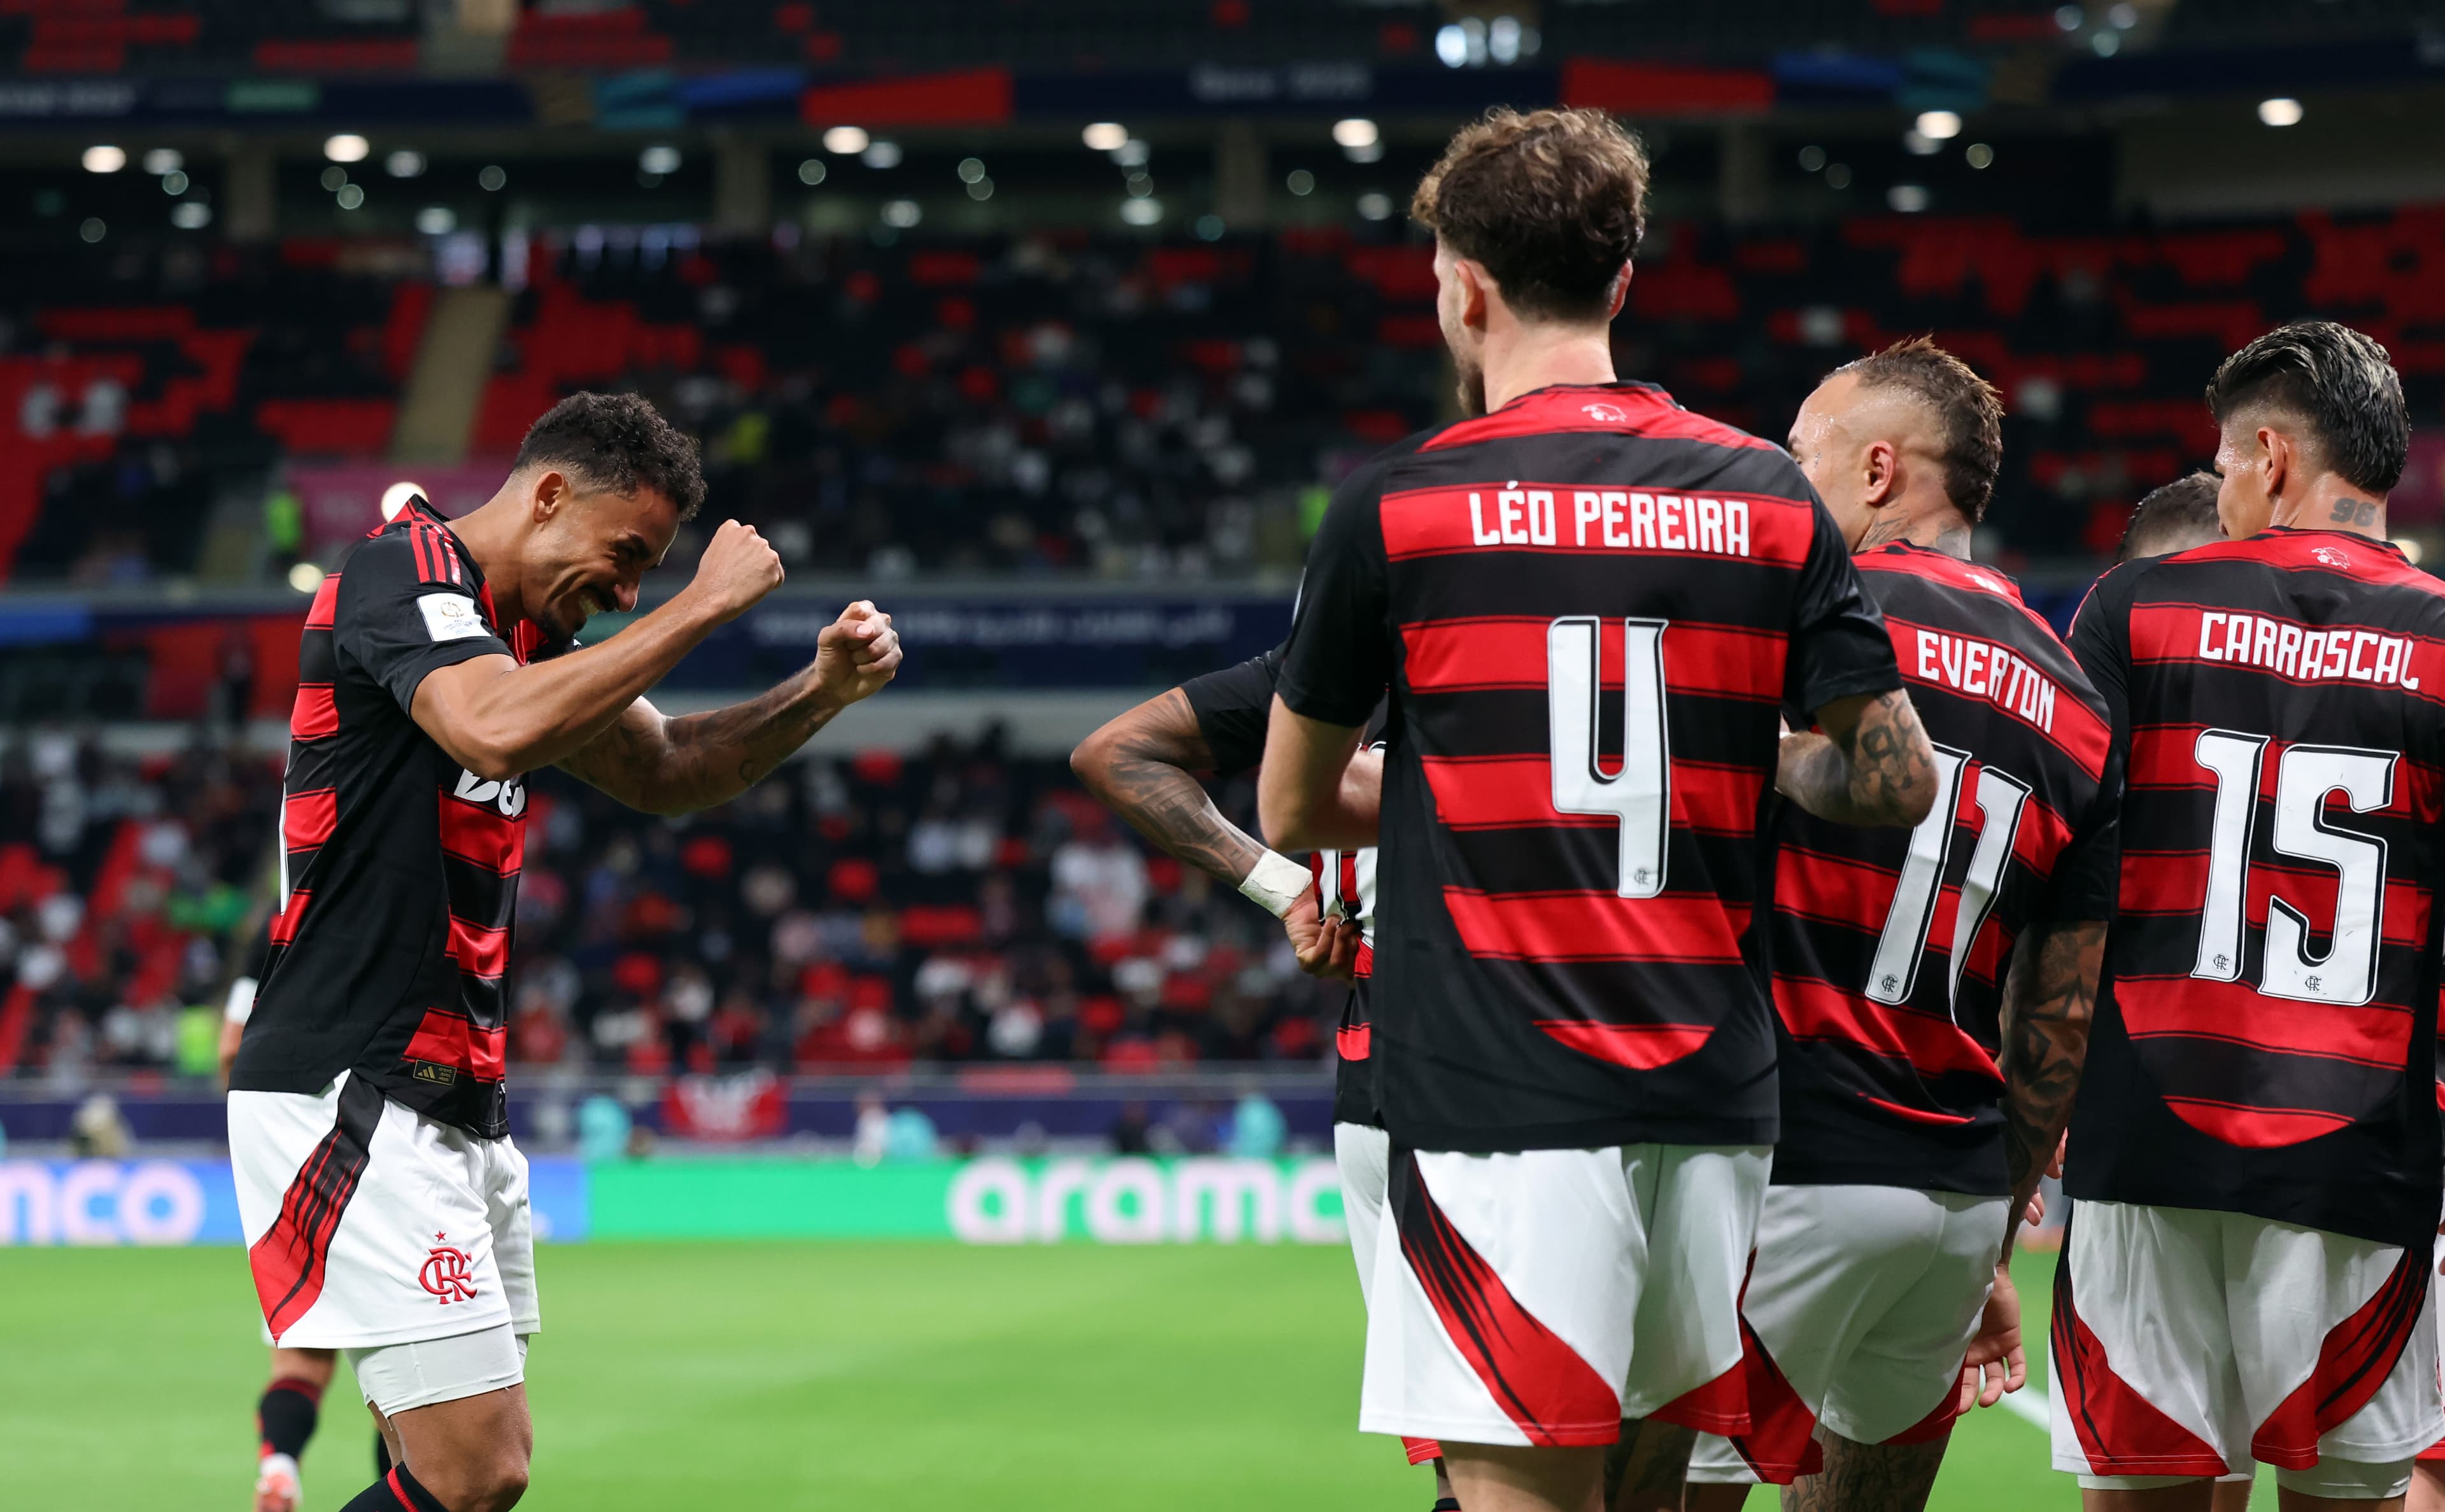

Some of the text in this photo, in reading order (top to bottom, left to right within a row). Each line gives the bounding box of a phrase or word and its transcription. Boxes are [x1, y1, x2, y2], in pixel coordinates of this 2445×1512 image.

[1469, 480, 1750, 557] LÉO PEREIRA
[1917, 629, 2055, 734] EVERTON
[2199, 612, 2419, 690] CARRASCAL
[1547, 615, 1671, 899] 4
[1864, 741, 2032, 1026] 11
[2190, 728, 2400, 1007] 15
